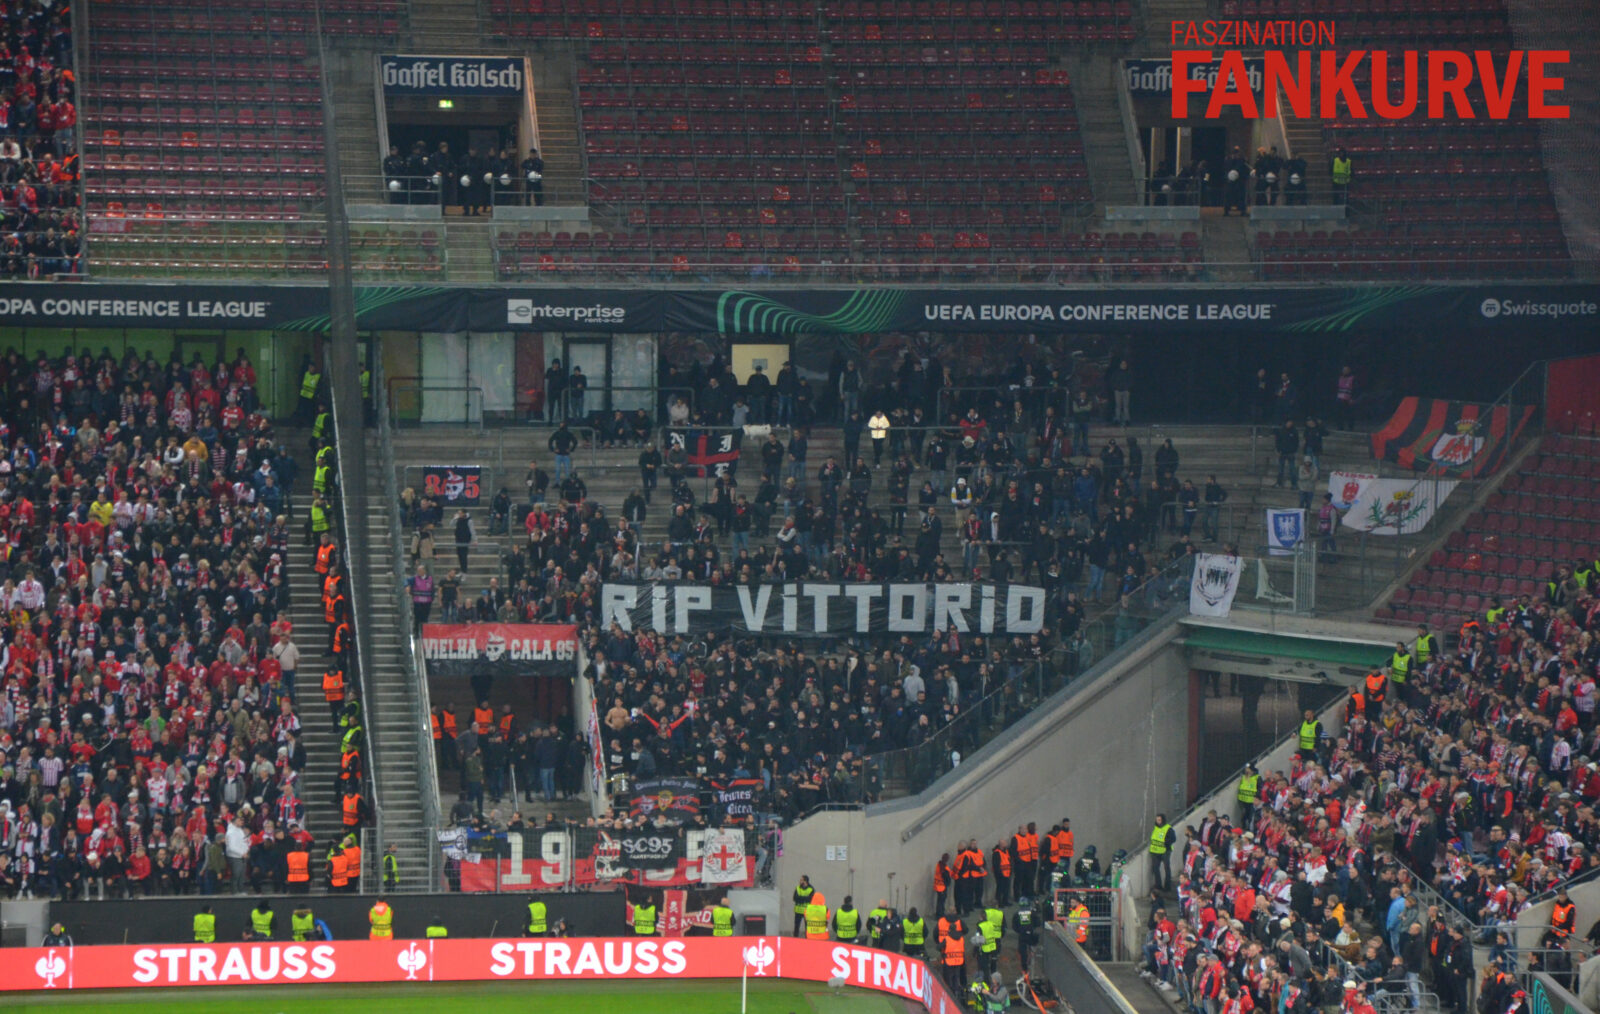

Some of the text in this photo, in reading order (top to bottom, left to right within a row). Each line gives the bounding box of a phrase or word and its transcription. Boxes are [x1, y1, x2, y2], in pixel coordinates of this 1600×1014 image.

[383, 62, 521, 91] Gaffel Kölsch
[42, 299, 180, 316] CONFERENCE
[187, 301, 266, 317] LEAGUE
[512, 303, 625, 321] enterprise
[925, 304, 1271, 320] UEFA EUROPA CONFERENCE LEAGUE
[1502, 299, 1598, 319] Swissquote
[423, 638, 478, 660] VIELHA
[511, 639, 553, 661] CALA
[132, 945, 336, 983] STRAUSS
[490, 940, 687, 976] STRAUSS
